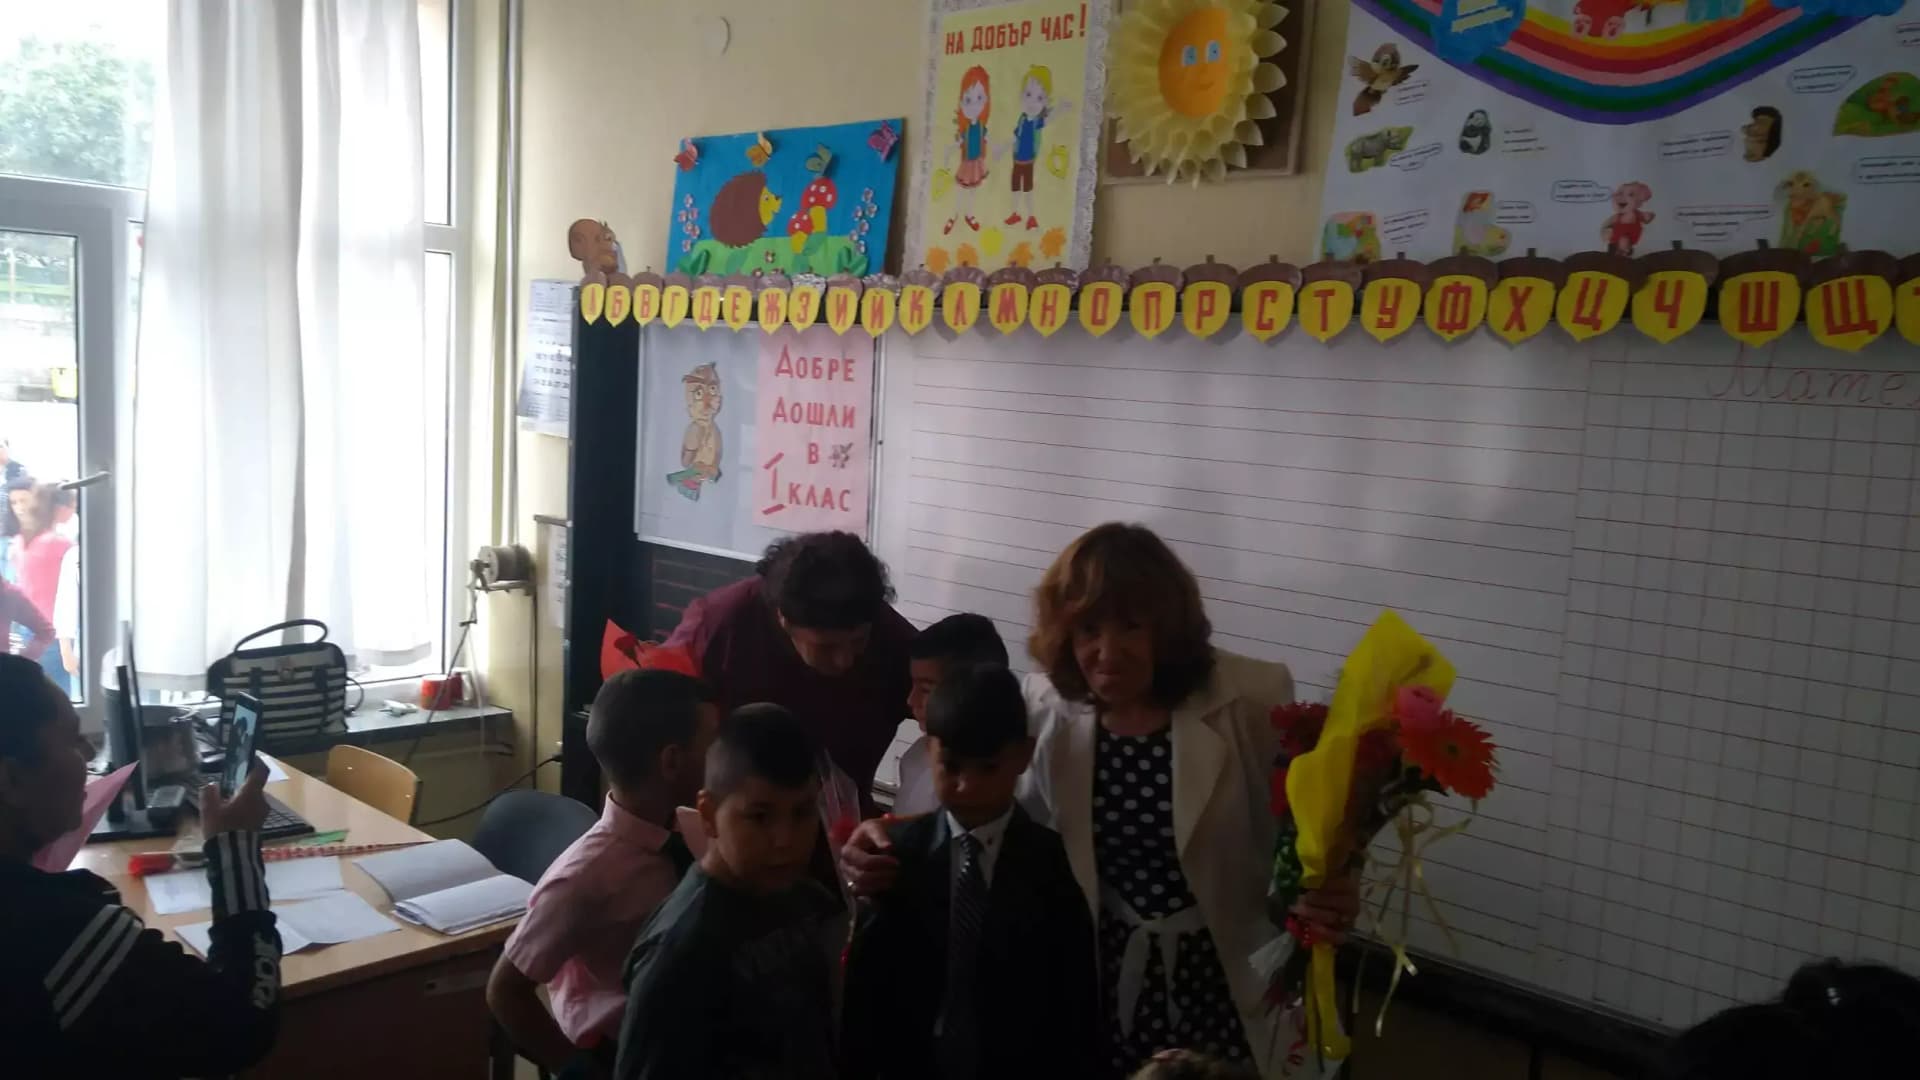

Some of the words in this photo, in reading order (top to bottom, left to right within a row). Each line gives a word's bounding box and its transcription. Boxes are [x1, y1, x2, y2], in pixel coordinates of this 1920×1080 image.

[944, 30, 965, 55] НА
[970, 20, 1033, 52] ДОБЪР
[1040, 3, 1087, 42] ЧАС!
[639, 288, 650, 318] В
[667, 291, 681, 322] Г
[699, 291, 712, 323] Д
[731, 291, 743, 323] Е
[764, 292, 781, 325] Ж
[796, 291, 810, 323] З
[834, 294, 849, 326] И
[909, 289, 925, 324] К
[997, 289, 1017, 323] М
[1040, 290, 1057, 327] Н
[1090, 287, 1109, 327] О
[1143, 290, 1162, 330] П
[1195, 289, 1217, 330] Р
[1255, 289, 1278, 331] С
[1313, 289, 1336, 332] Т
[1376, 287, 1402, 330] У
[1436, 280, 1472, 334] Ф
[1504, 287, 1533, 331] Х
[1572, 278, 1608, 331] Ц
[1654, 280, 1684, 330] Ч
[1738, 281, 1779, 333] Ш
[1822, 279, 1878, 336] Щ
[774, 344, 857, 383] ДОБРЕ
[1706, 340, 1920, 407] Мате
[772, 397, 857, 429] ДОШЛИ
[808, 442, 820, 465] В
[788, 482, 852, 513] КЛАС
